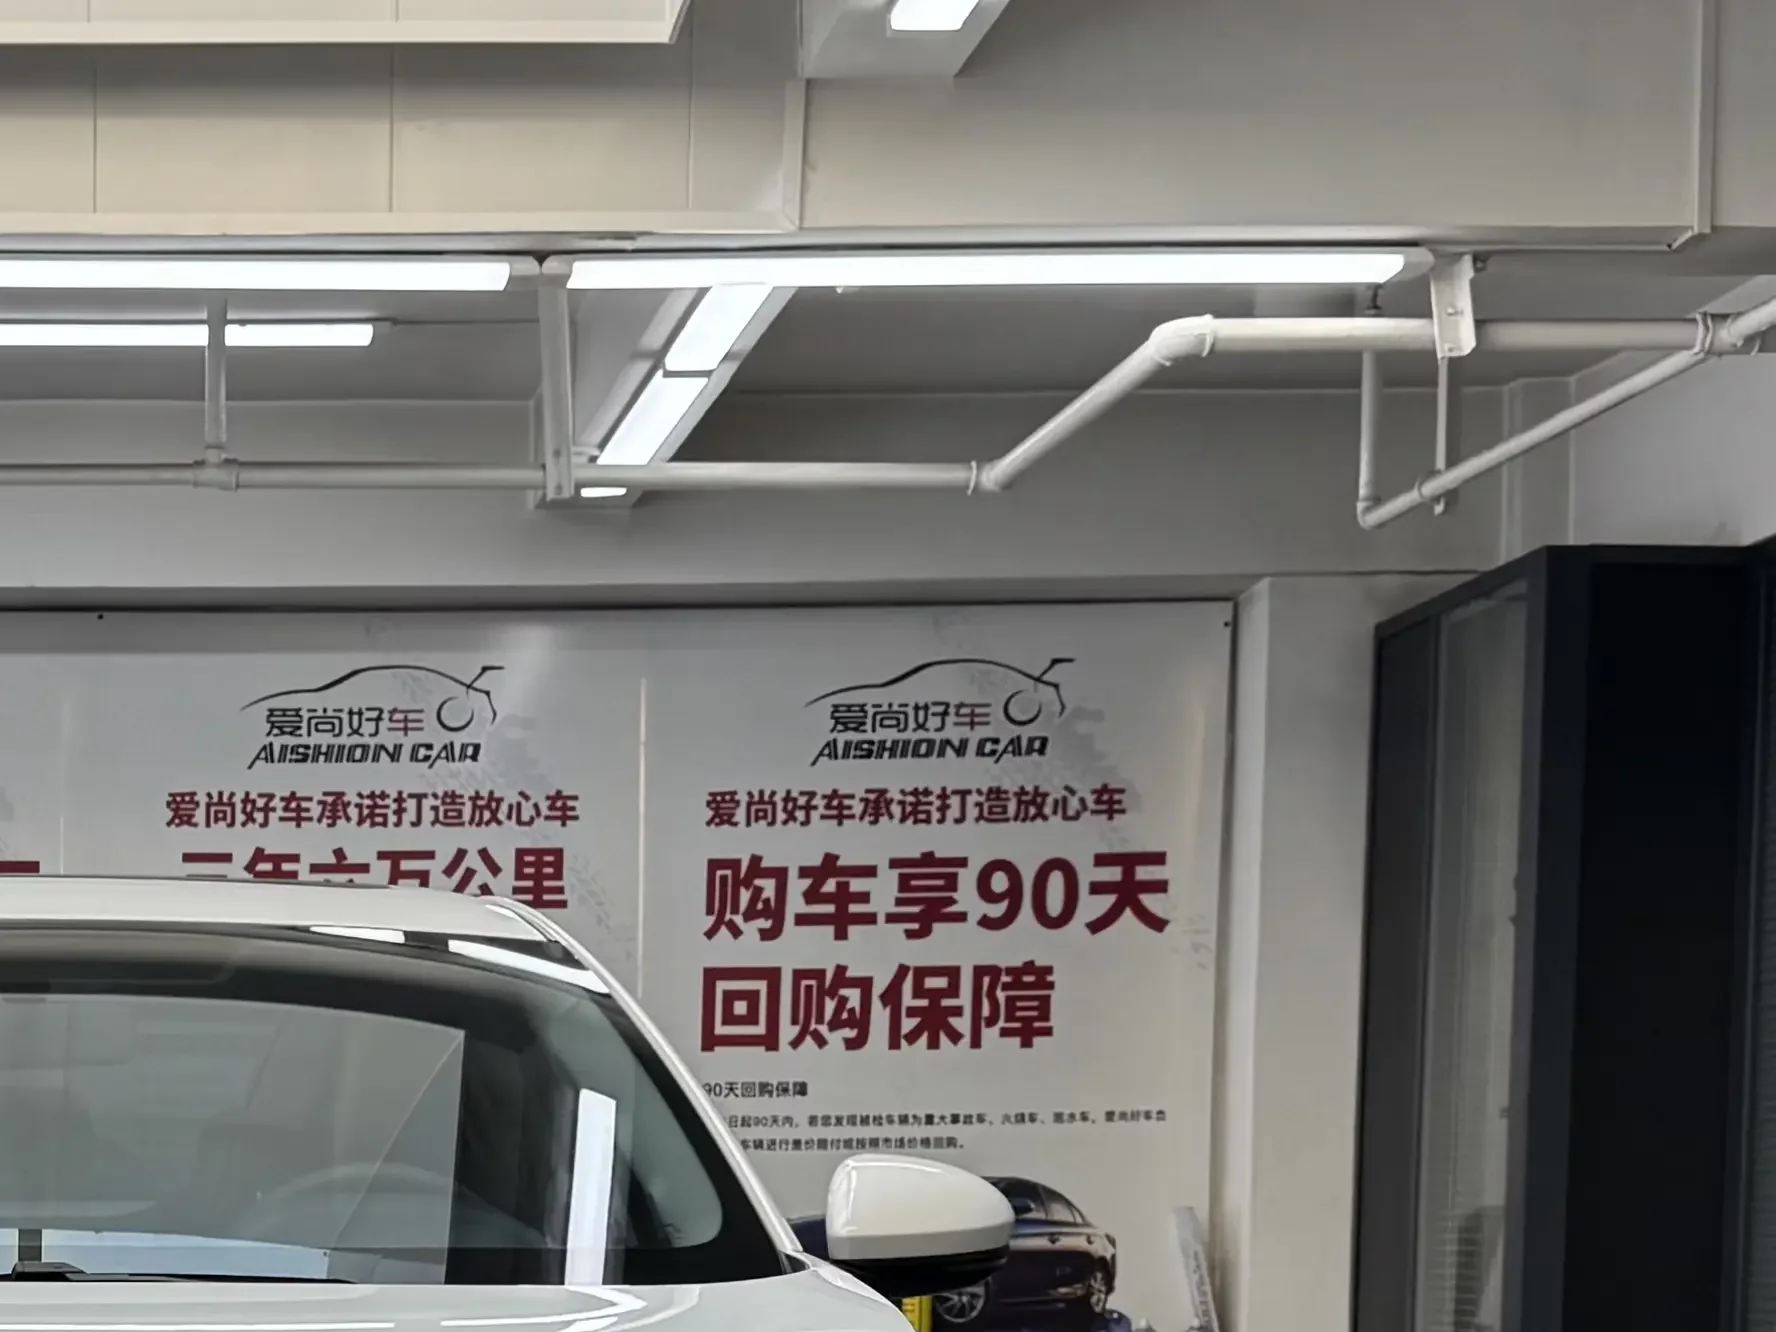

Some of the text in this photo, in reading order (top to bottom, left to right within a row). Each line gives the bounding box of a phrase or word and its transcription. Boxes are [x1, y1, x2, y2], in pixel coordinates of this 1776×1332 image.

[265, 706, 425, 738] 爱尚好车
[829, 701, 992, 734] 爱尚好车
[246, 740, 482, 771] AISHION CAR
[810, 734, 1050, 767] AISHION CAR
[165, 788, 580, 829] 爱尚好车承诺打造放心车
[705, 782, 1128, 828] 爱尚好车承诺打造放心车
[702, 850, 1171, 942] 购车享90天
[700, 960, 1056, 1052] 回购保障
